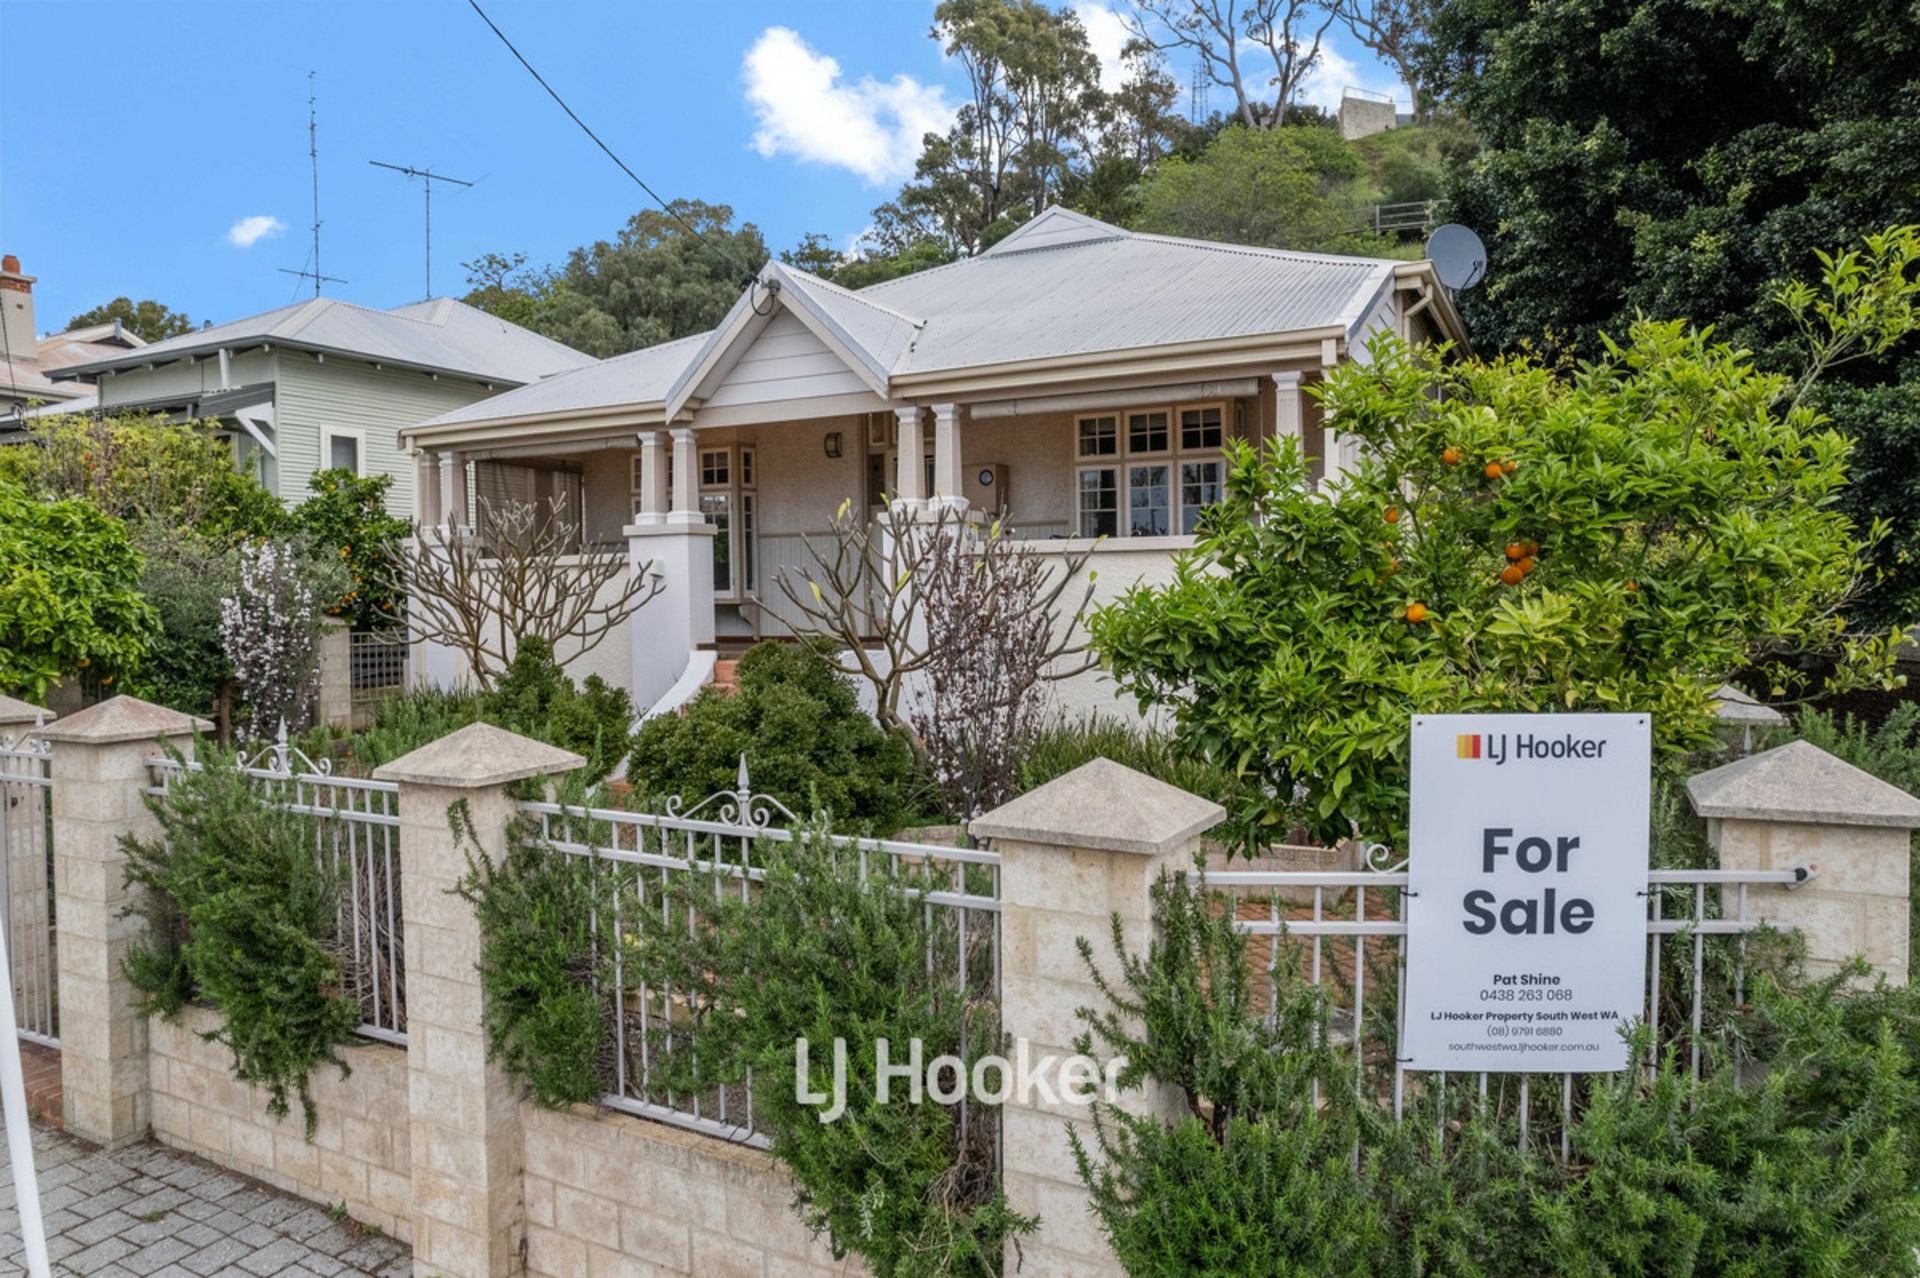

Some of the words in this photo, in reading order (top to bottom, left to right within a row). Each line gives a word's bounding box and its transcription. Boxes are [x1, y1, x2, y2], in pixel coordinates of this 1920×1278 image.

[1487, 733, 1507, 766] LJ
[1515, 733, 1608, 759] Hooker
[1482, 827, 1581, 874] For
[1462, 887, 1596, 936] Sale
[1493, 973, 1518, 986] Pat
[1520, 972, 1562, 986] Shine
[1479, 988, 1515, 1002] 0438
[1517, 988, 1544, 1002] 263
[1546, 988, 1574, 1002] 068
[1430, 1011, 1443, 1021] LJ
[1444, 1011, 1484, 1021] Hooker
[1486, 1011, 1533, 1022] Property
[1535, 1011, 1568, 1021] South
[1570, 1011, 1599, 1021] West
[1600, 1010, 1619, 1021] WA
[1487, 1024, 1510, 1038] (08)
[1511, 1025, 1534, 1037] 9791
[1535, 1025, 1564, 1037] 6880
[1448, 1042, 1600, 1054] southwestwa.ljhooker.com.au
